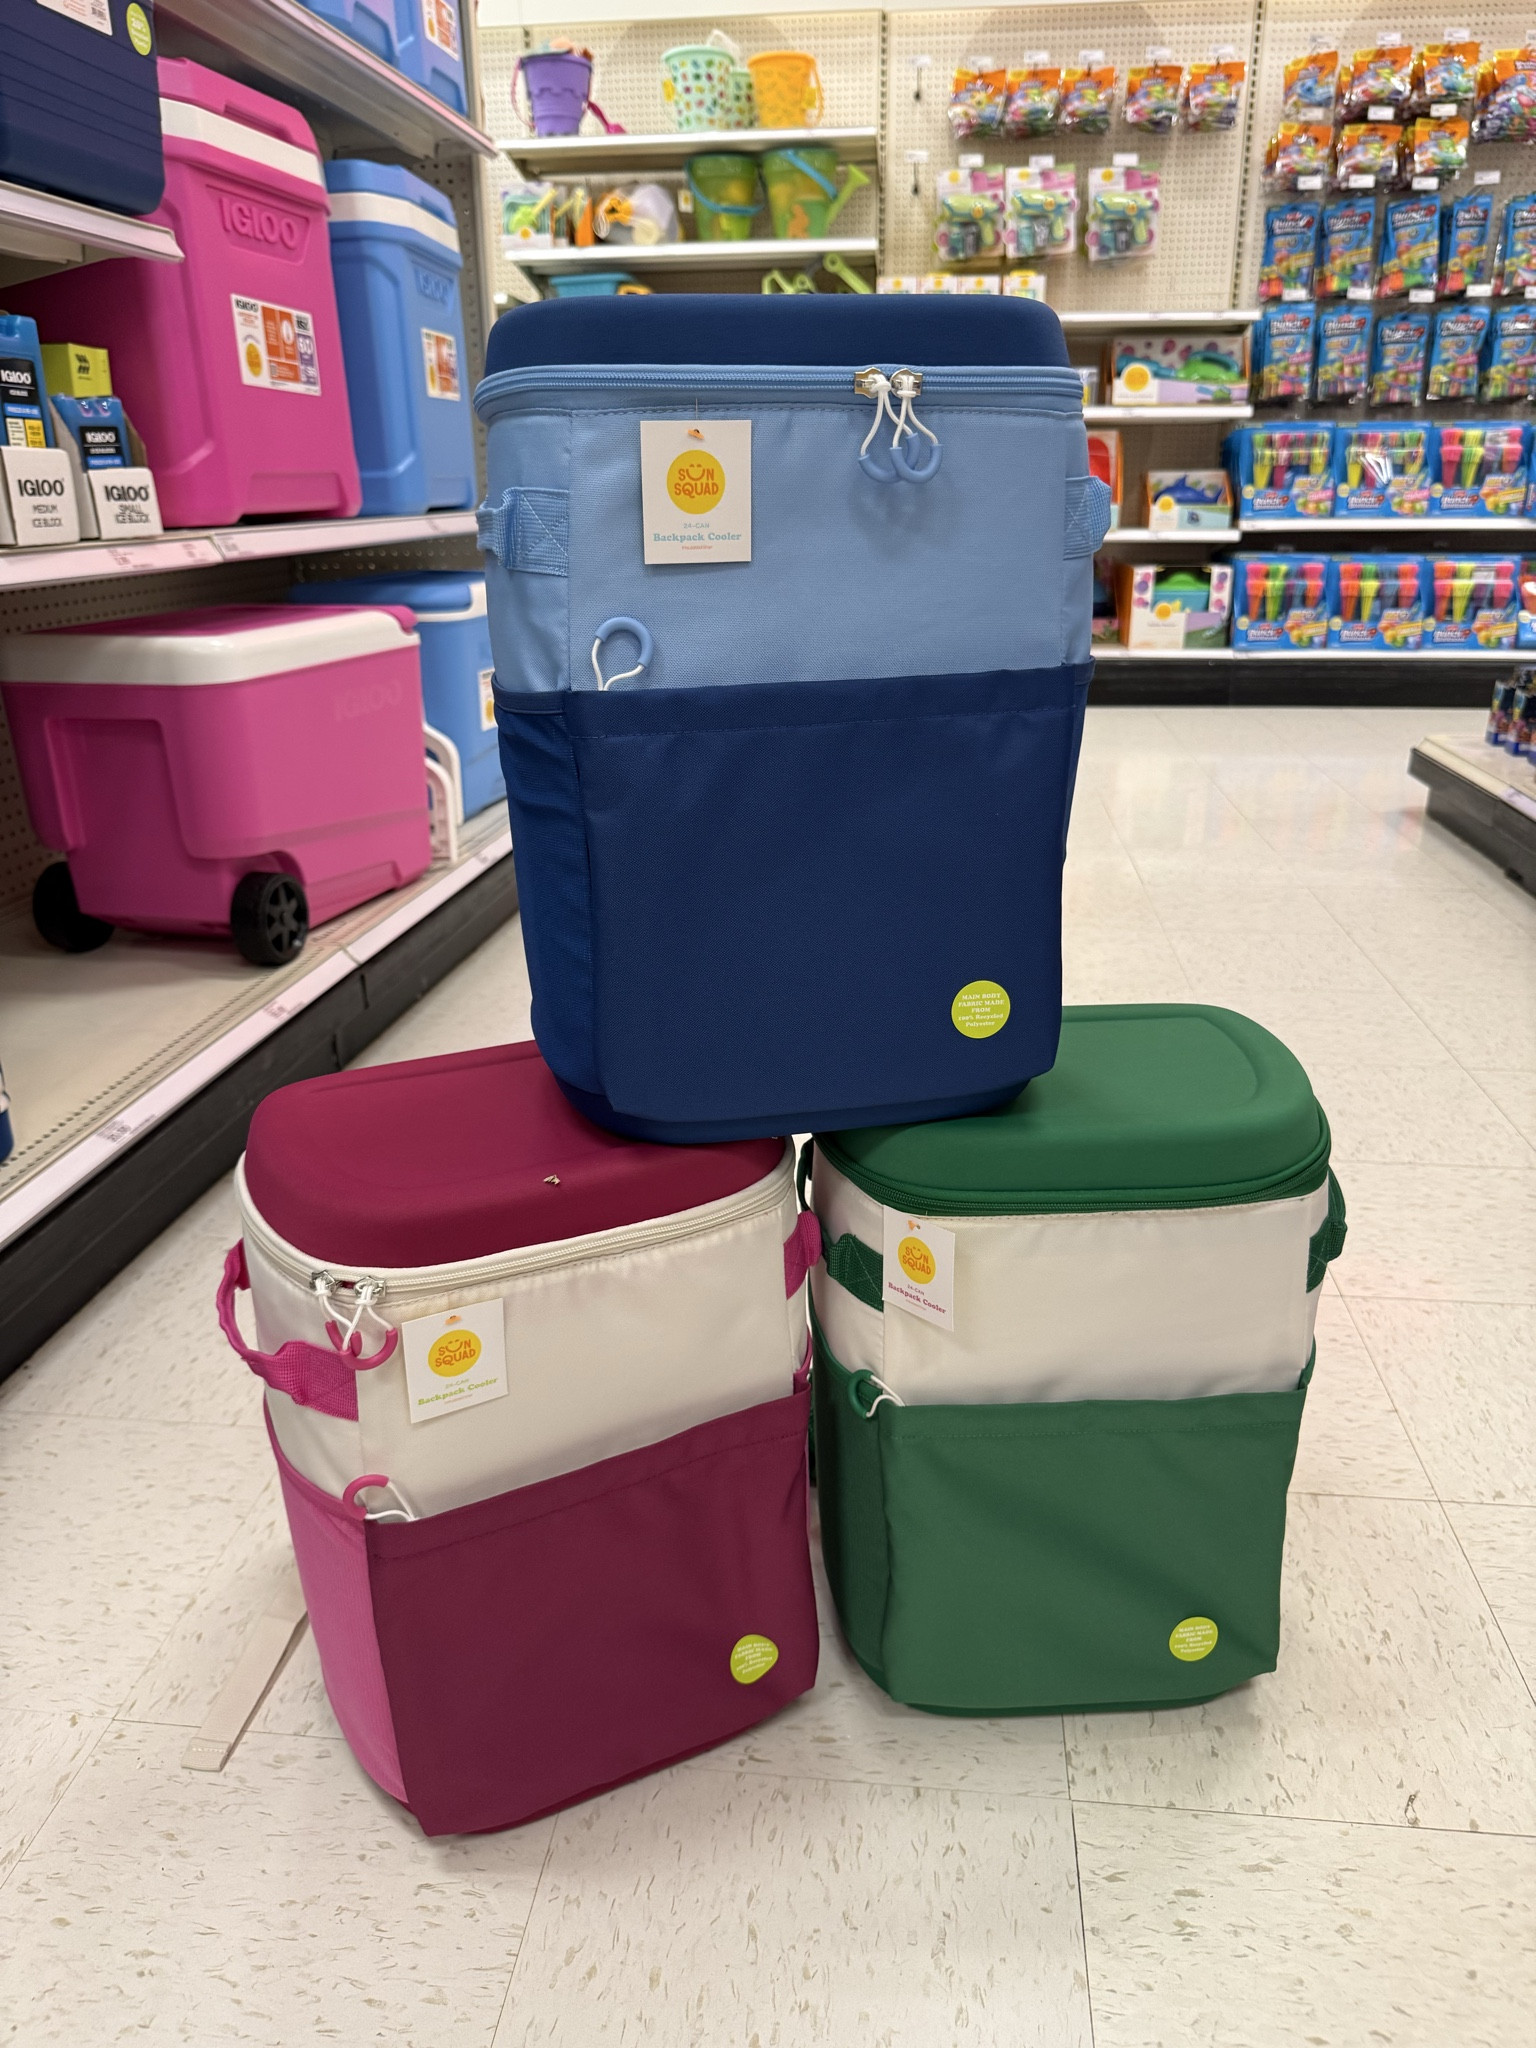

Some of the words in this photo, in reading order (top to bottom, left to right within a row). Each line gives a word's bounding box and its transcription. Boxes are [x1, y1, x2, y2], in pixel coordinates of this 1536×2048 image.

[219, 196, 298, 251] IGLOO
[1, 370, 31, 384] IGLOO
[85, 431, 116, 443] IGLOO
[678, 466, 714, 481] SUN
[18, 479, 64, 496] IGLOO
[104, 486, 149, 501] IGLOO
[674, 482, 719, 498] SQUAD
[653, 533, 705, 544] Backpack
[708, 532, 741, 541] Cooler
[905, 1246, 929, 1263] SUN
[902, 1255, 931, 1275] SQUAD
[888, 1282, 921, 1302] Backpack
[923, 1298, 947, 1314] Cooler
[438, 1339, 472, 1356] SUN
[435, 1349, 476, 1368] SQUAD
[418, 1388, 466, 1406] Backpack
[467, 1378, 498, 1391] Cooler
